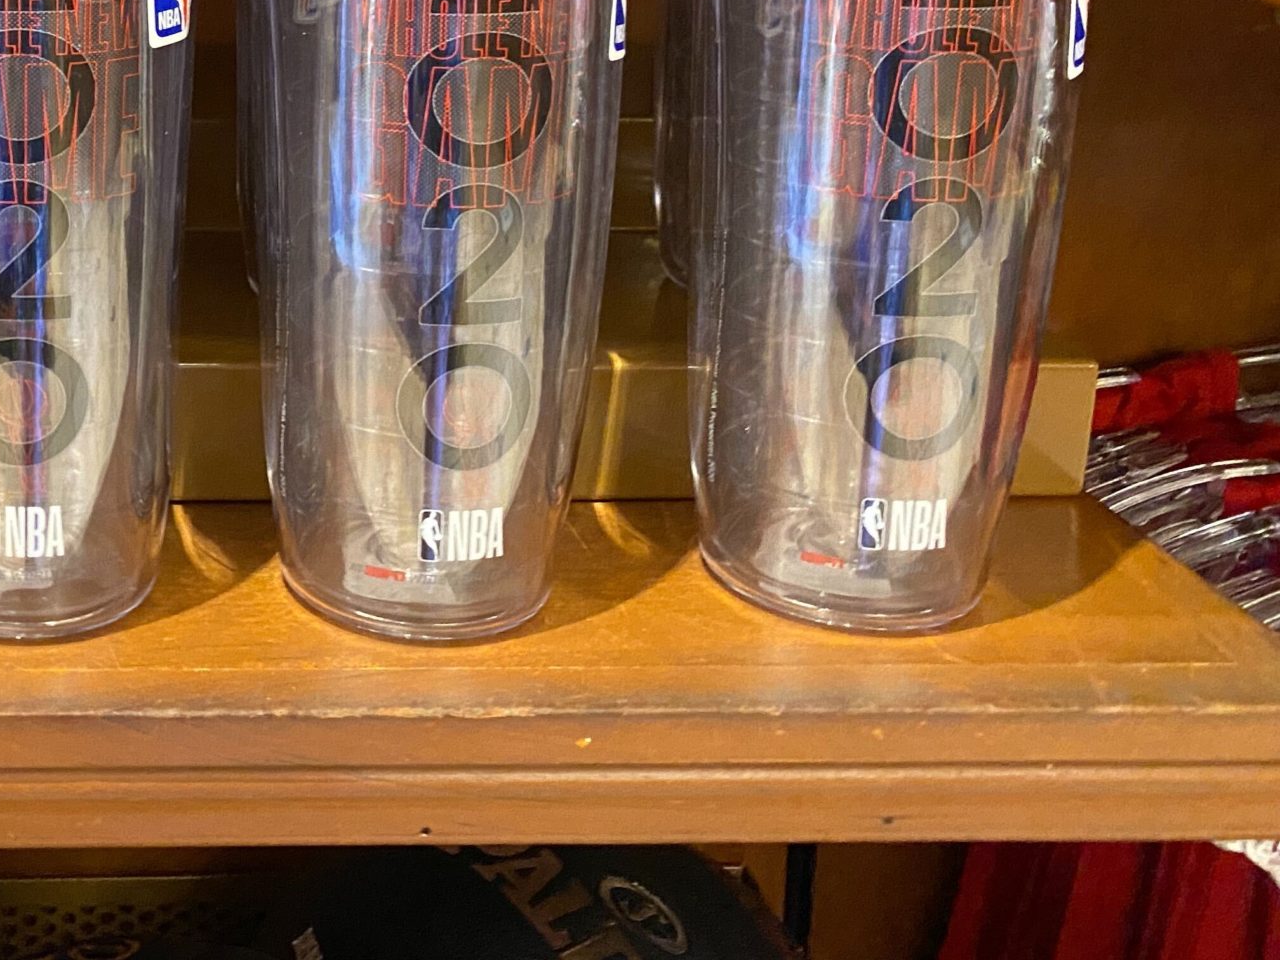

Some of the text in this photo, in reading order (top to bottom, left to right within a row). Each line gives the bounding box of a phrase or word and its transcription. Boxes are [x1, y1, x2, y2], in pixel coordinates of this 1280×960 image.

[157, 6, 182, 32] NBA
[808, 53, 1035, 203] GAM
[4, 504, 66, 558] NBA
[447, 506, 505, 562] NBA
[887, 498, 948, 552] NBA
